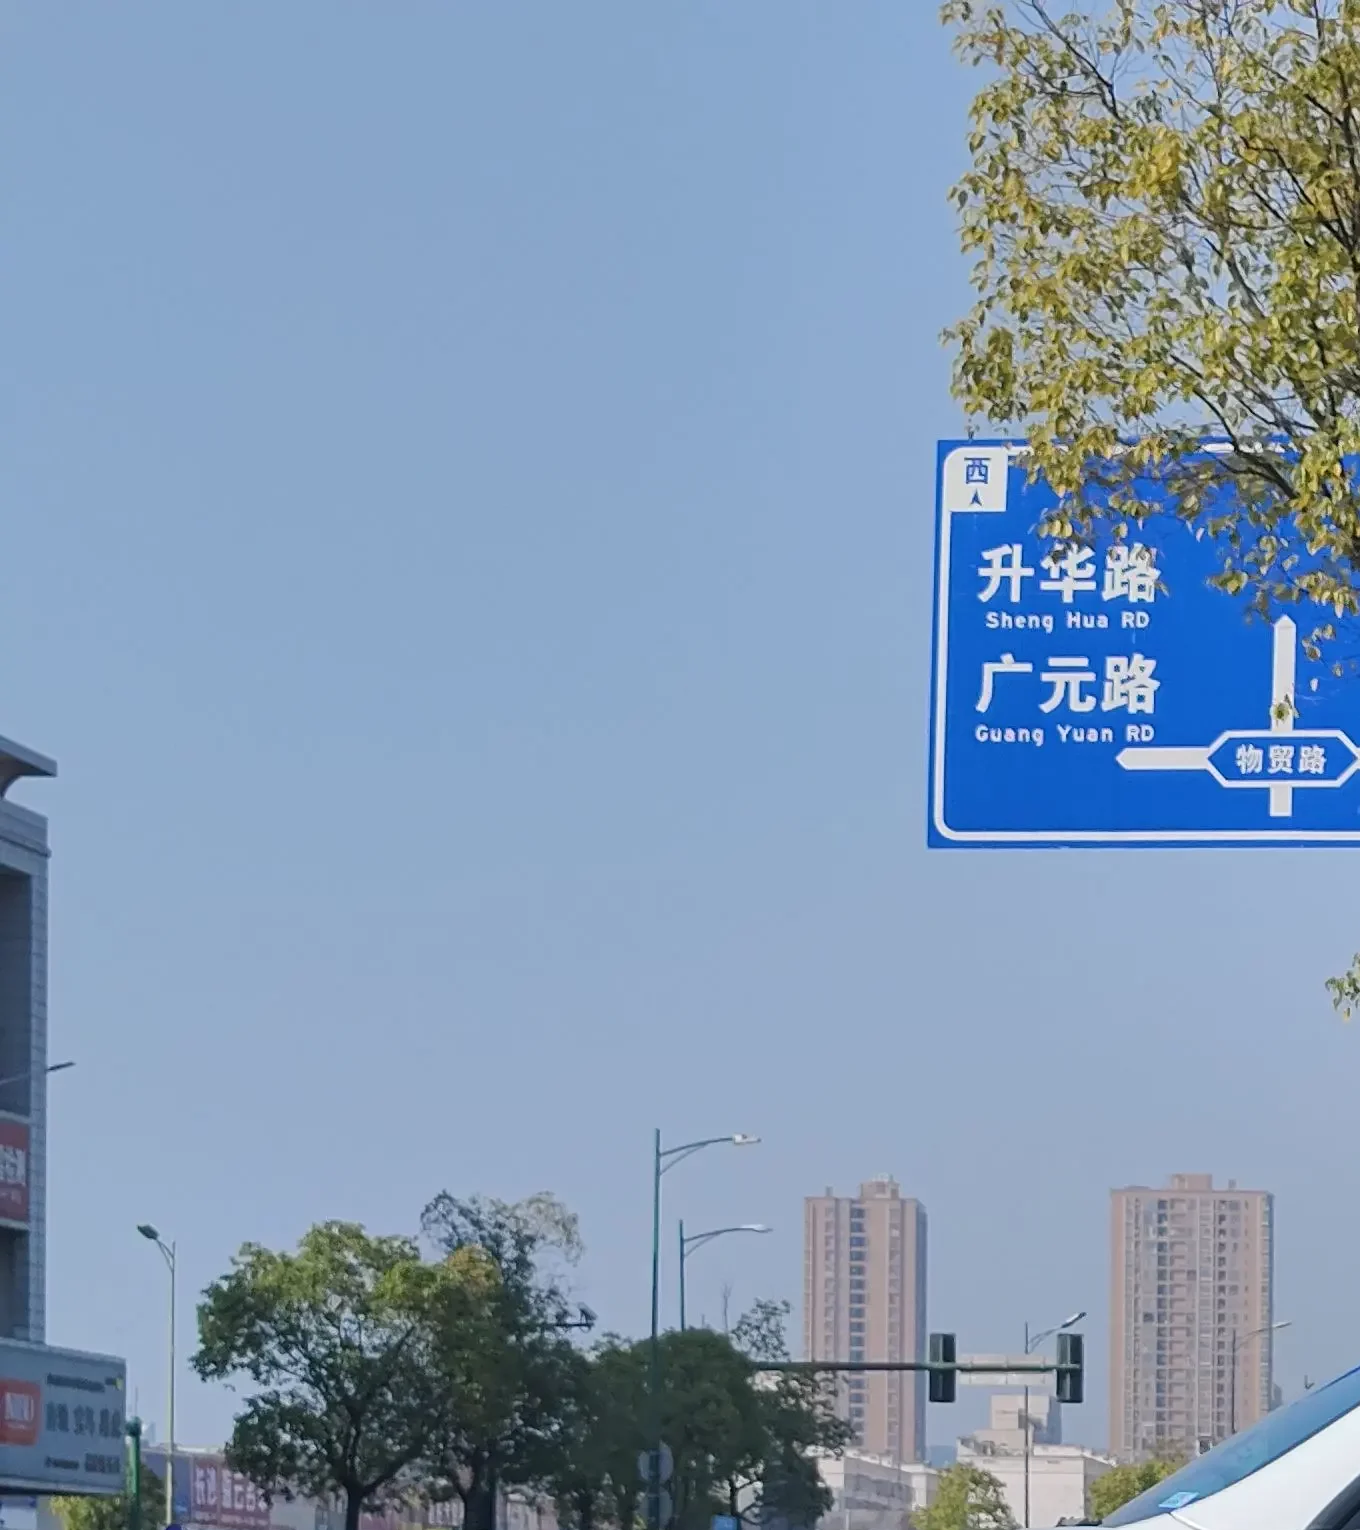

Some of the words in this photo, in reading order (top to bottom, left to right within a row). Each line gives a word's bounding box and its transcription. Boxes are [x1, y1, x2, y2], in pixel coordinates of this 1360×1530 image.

[963, 456, 992, 485] 西
[976, 543, 1161, 603] 升华路
[985, 610, 1054, 634] Sheng
[1065, 610, 1109, 630] Hua
[1120, 610, 1150, 630] RD
[974, 652, 1161, 714] 广元路
[974, 723, 1044, 747] Guang
[1056, 723, 1114, 743] Yuan
[1125, 723, 1156, 744] RD
[1234, 743, 1328, 775] 物贸路
